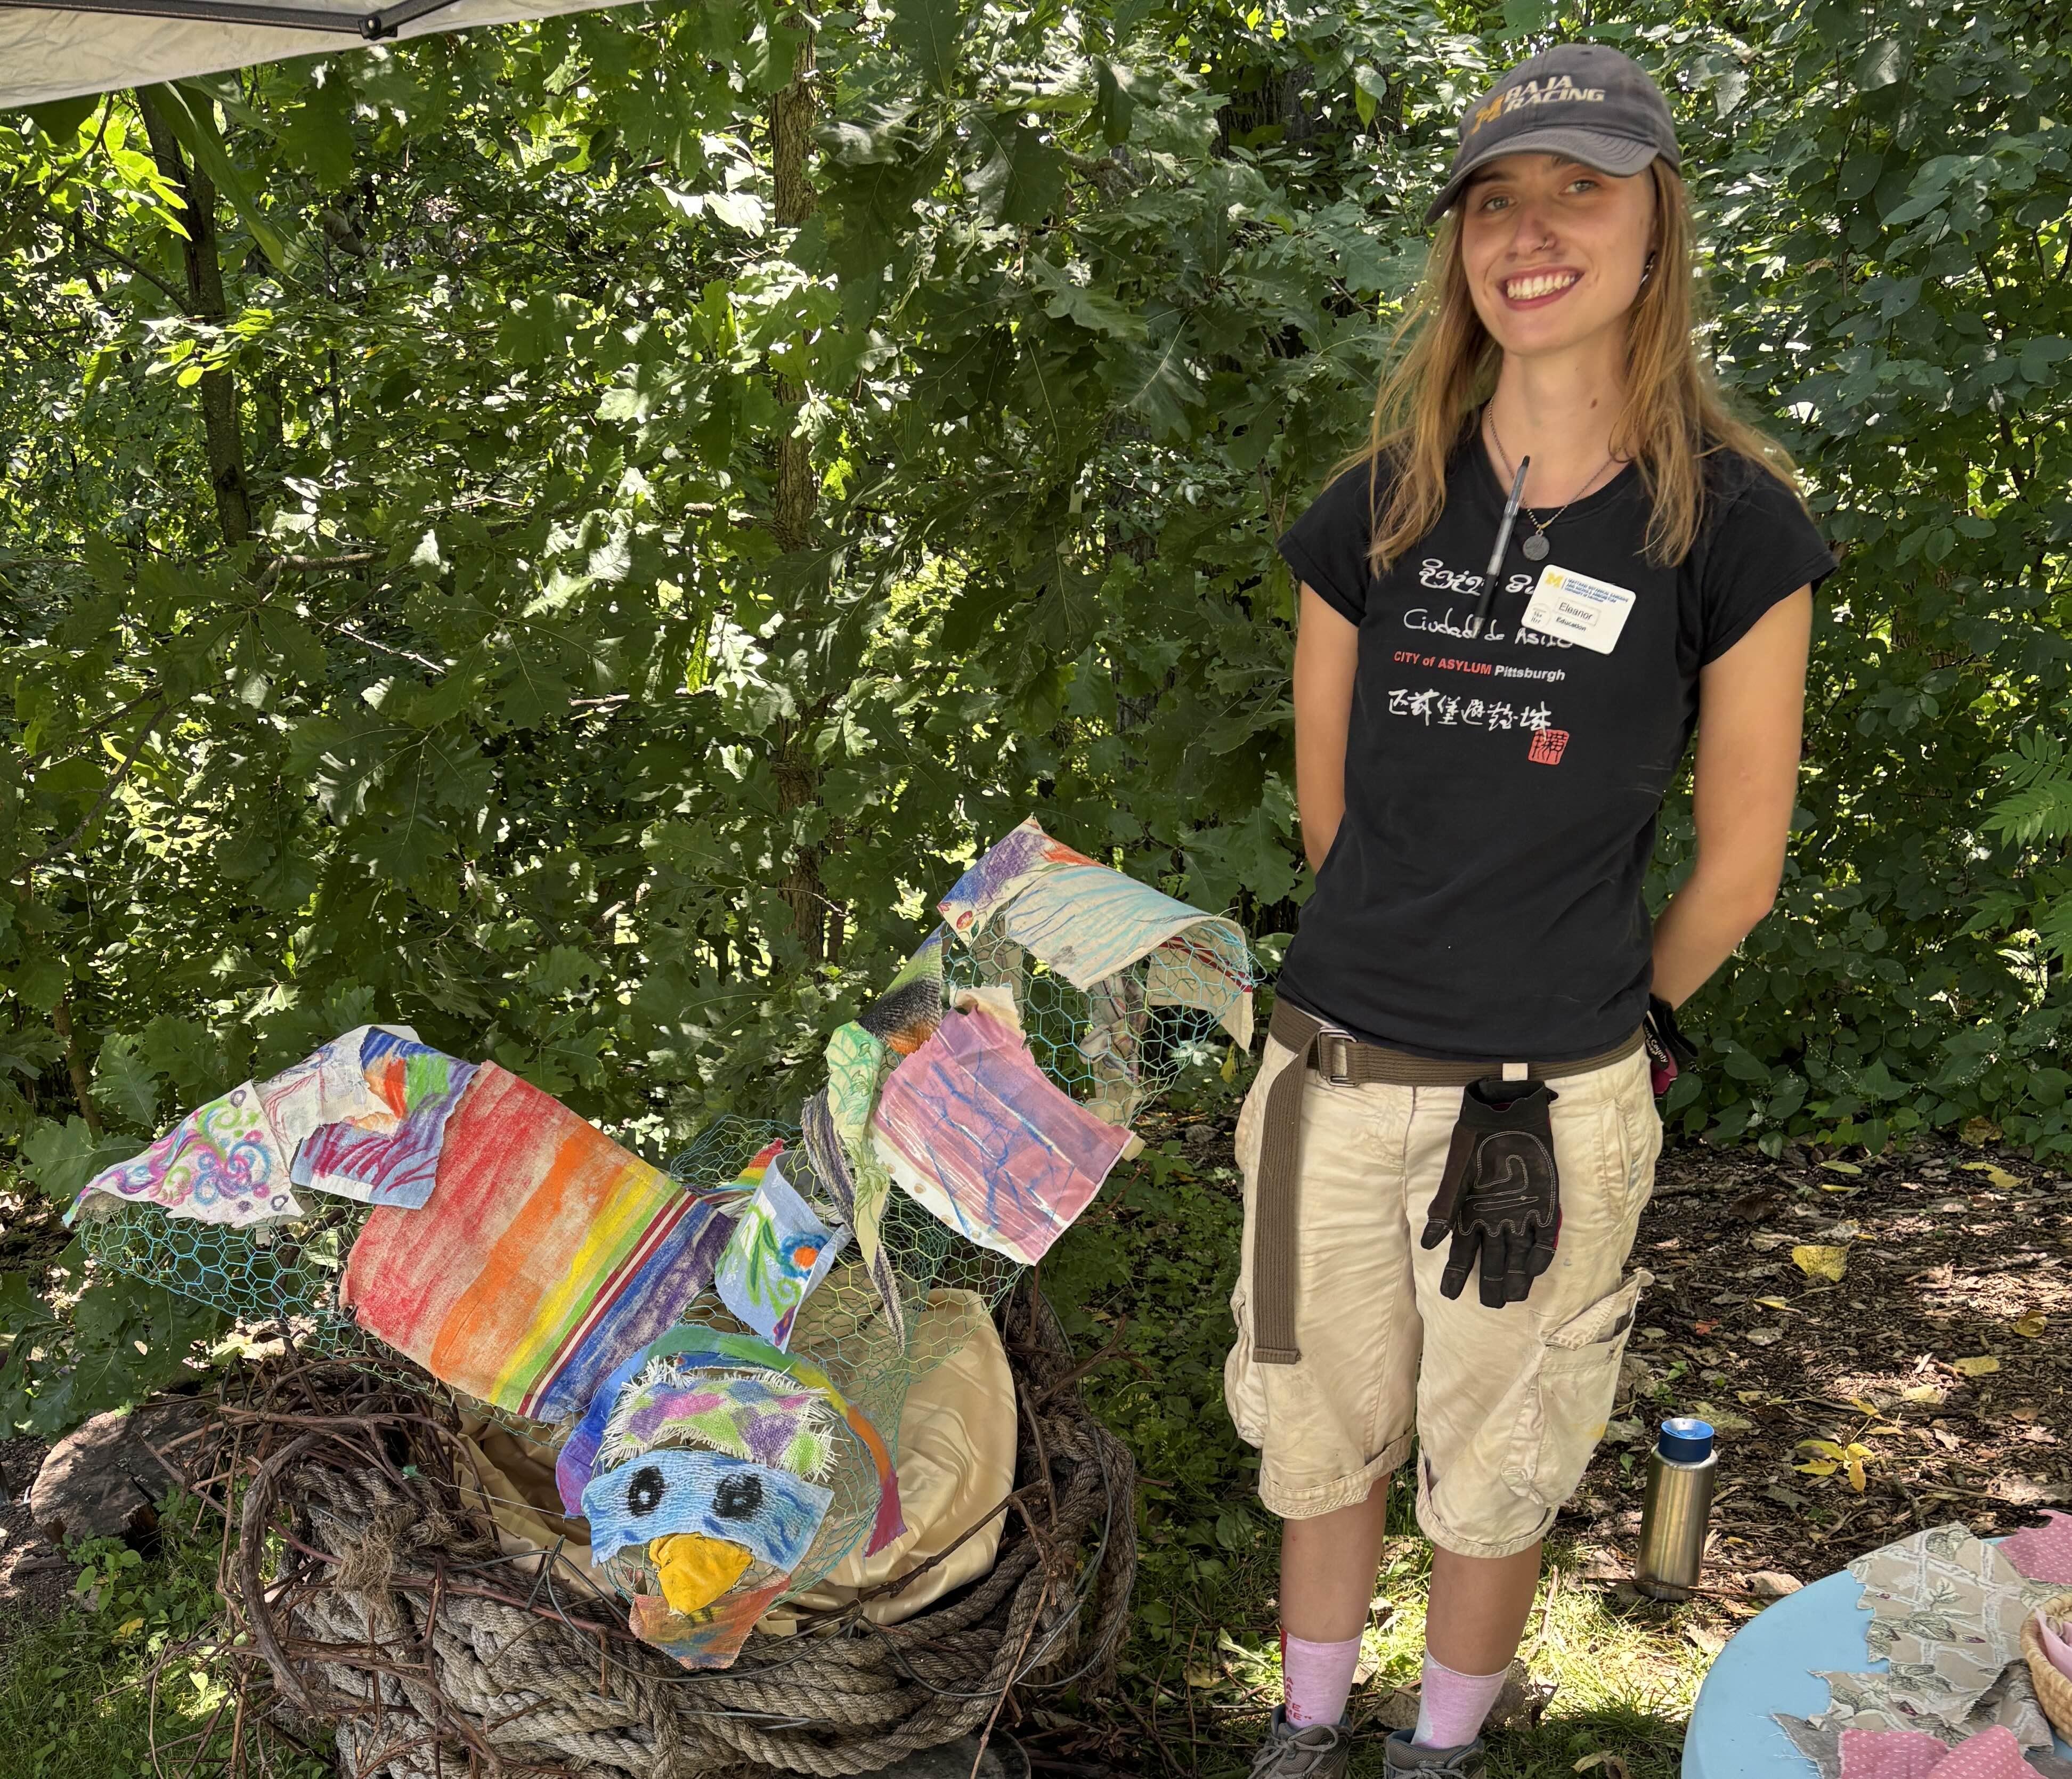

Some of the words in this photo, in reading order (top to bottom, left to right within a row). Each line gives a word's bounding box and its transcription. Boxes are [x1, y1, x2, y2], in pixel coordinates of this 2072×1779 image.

[1503, 88, 1606, 115] RACING
[1504, 75, 1573, 103] BAJA
[1403, 607, 1477, 639] Ciudad
[1556, 616, 1587, 632] Education
[1559, 602, 1594, 621] Eleanor
[1394, 651, 1420, 664] CITY
[1422, 656, 1435, 667] of
[1438, 658, 1492, 675] ASYLUM
[1494, 665, 1565, 683] Pittsburgh
